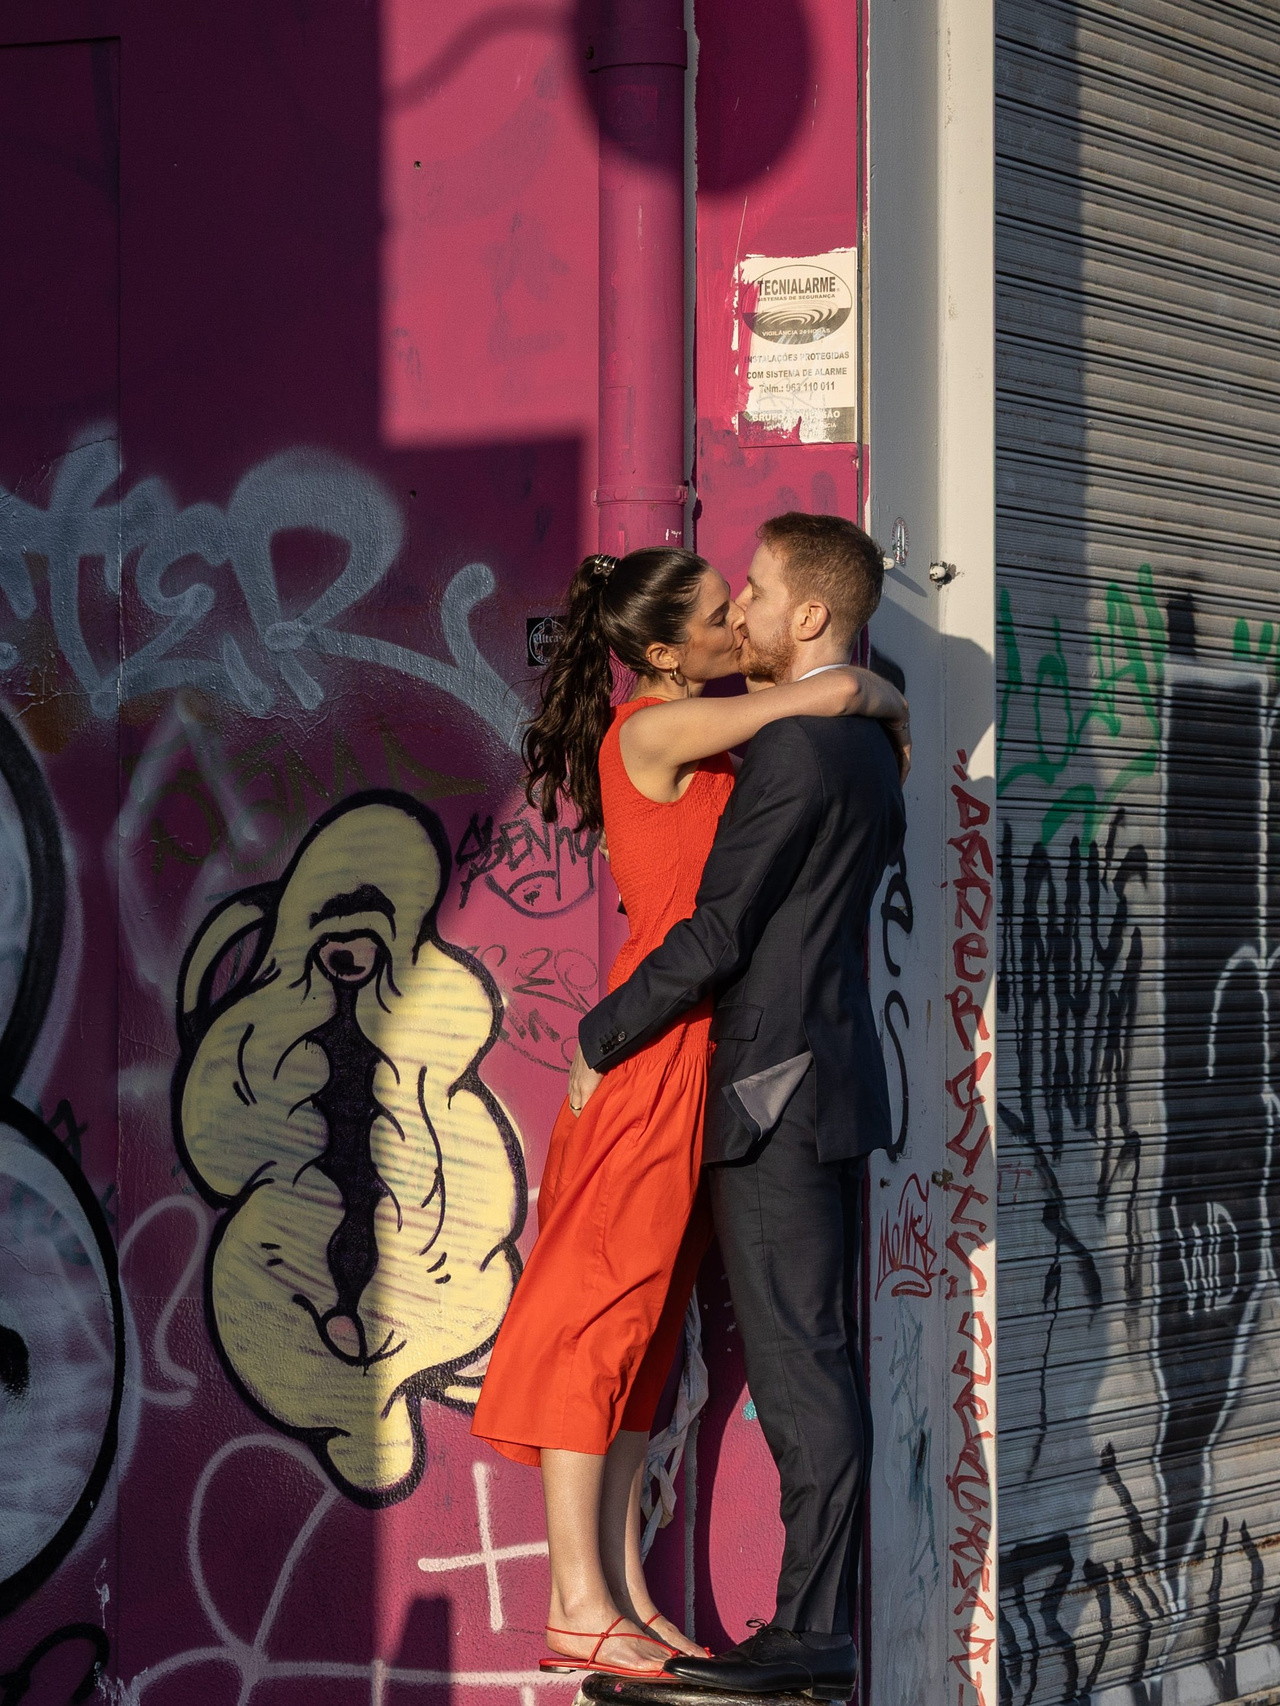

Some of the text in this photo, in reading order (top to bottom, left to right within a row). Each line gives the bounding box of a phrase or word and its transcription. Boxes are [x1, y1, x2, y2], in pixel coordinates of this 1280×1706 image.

[757, 276, 836, 297] TECNIALARME
[746, 367, 848, 380] COM SISTEMA DE ALARME
[803, 381, 818, 392] 110
[820, 380, 835, 391] 011
